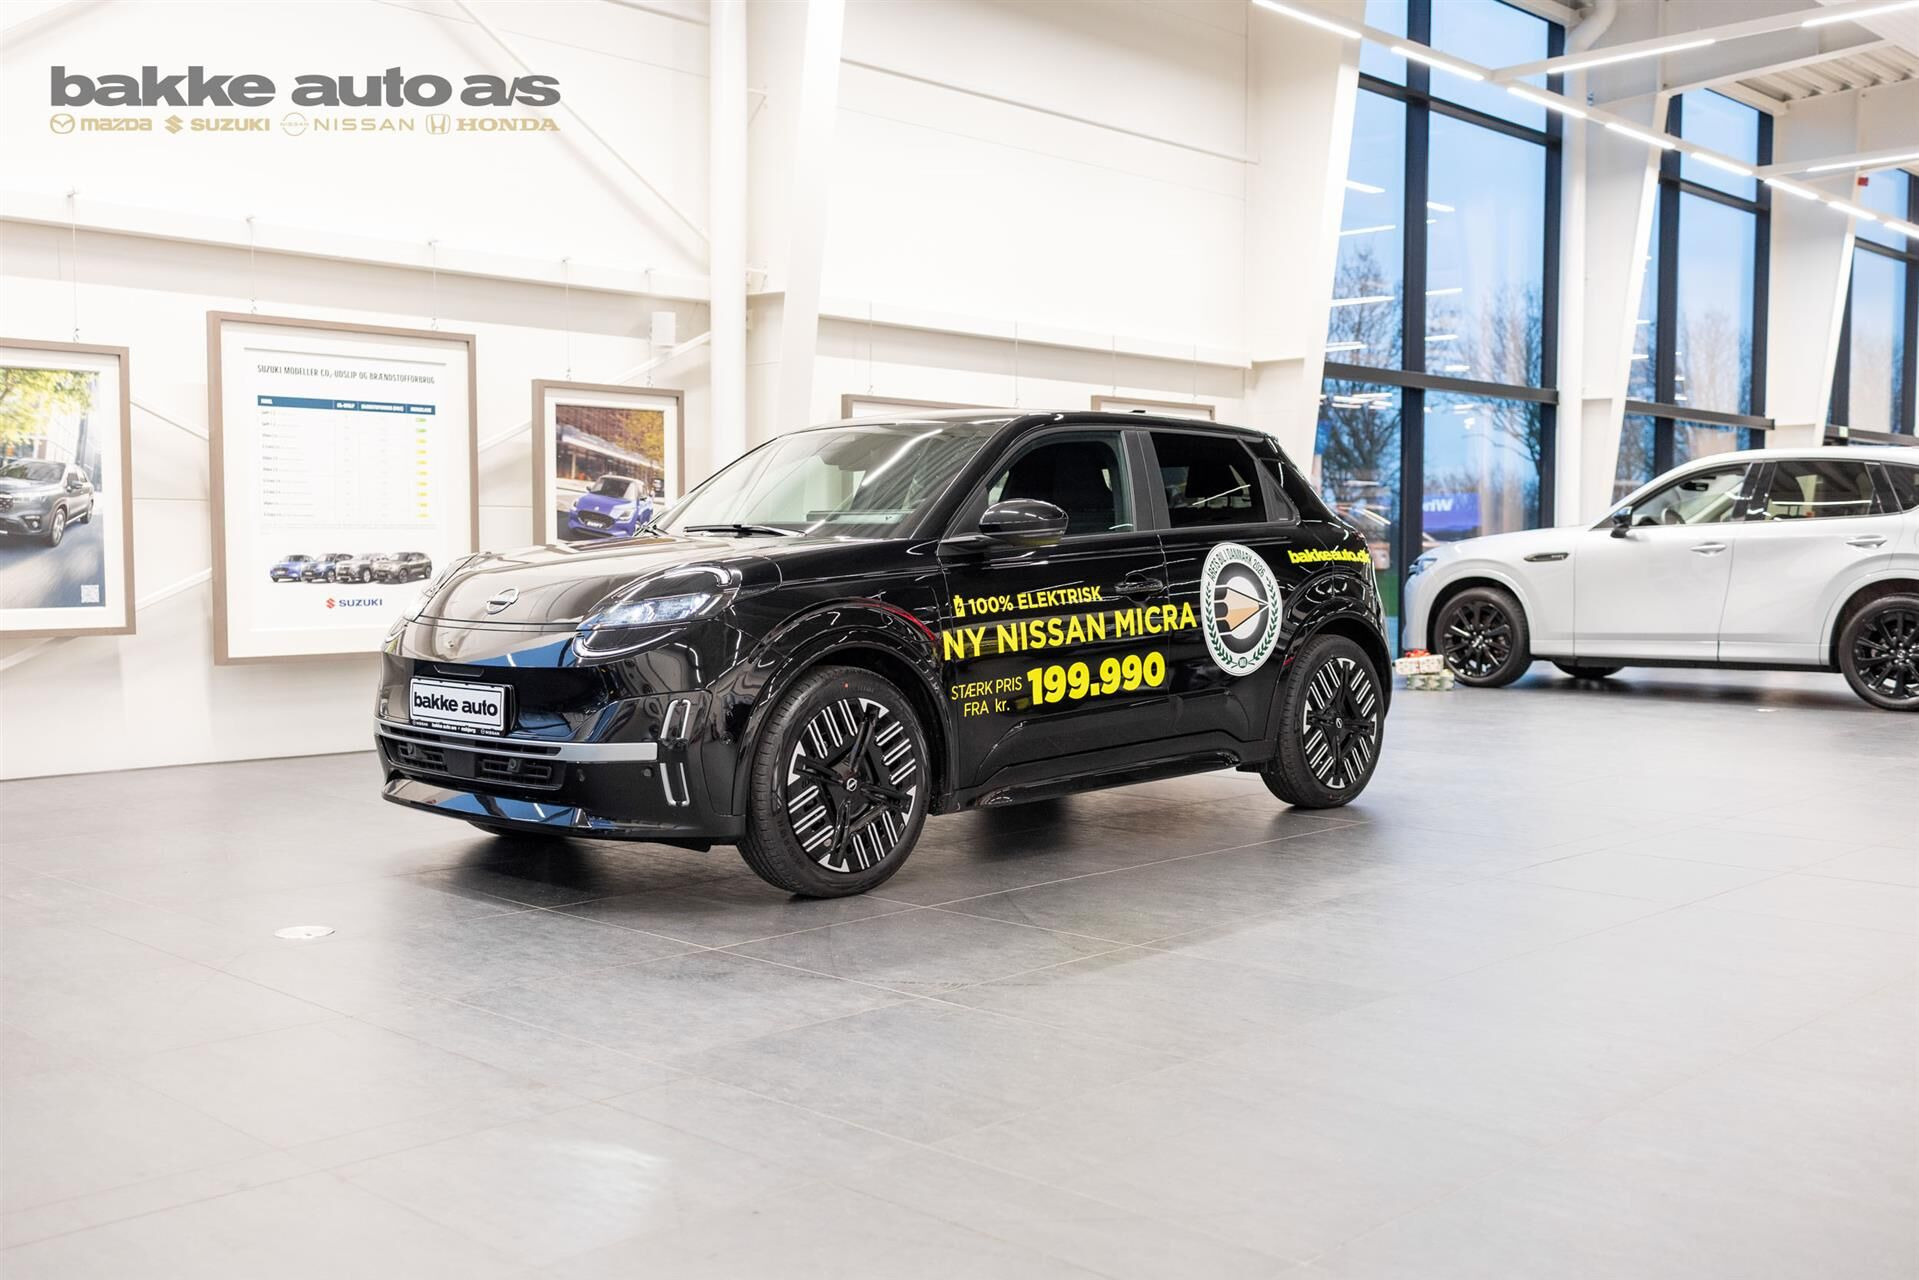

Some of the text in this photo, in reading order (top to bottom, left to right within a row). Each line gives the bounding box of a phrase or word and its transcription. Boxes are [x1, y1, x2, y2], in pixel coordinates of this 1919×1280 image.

[257, 364, 282, 374] SUZUKI
[284, 366, 319, 376] MODELLER
[334, 370, 357, 380] UDSLIP
[359, 372, 368, 380] OG
[1252, 558, 1266, 577] 2026
[339, 598, 383, 608] SUZUKI
[967, 586, 1104, 615] 100% ELEKTRISK
[942, 602, 1198, 661] NY NISSAN MICRA
[951, 676, 1023, 701] STÆRK PRIS
[1027, 651, 1166, 706] 199.990
[414, 691, 498, 717] bakke auto
[963, 697, 1010, 717] FRA kr.
